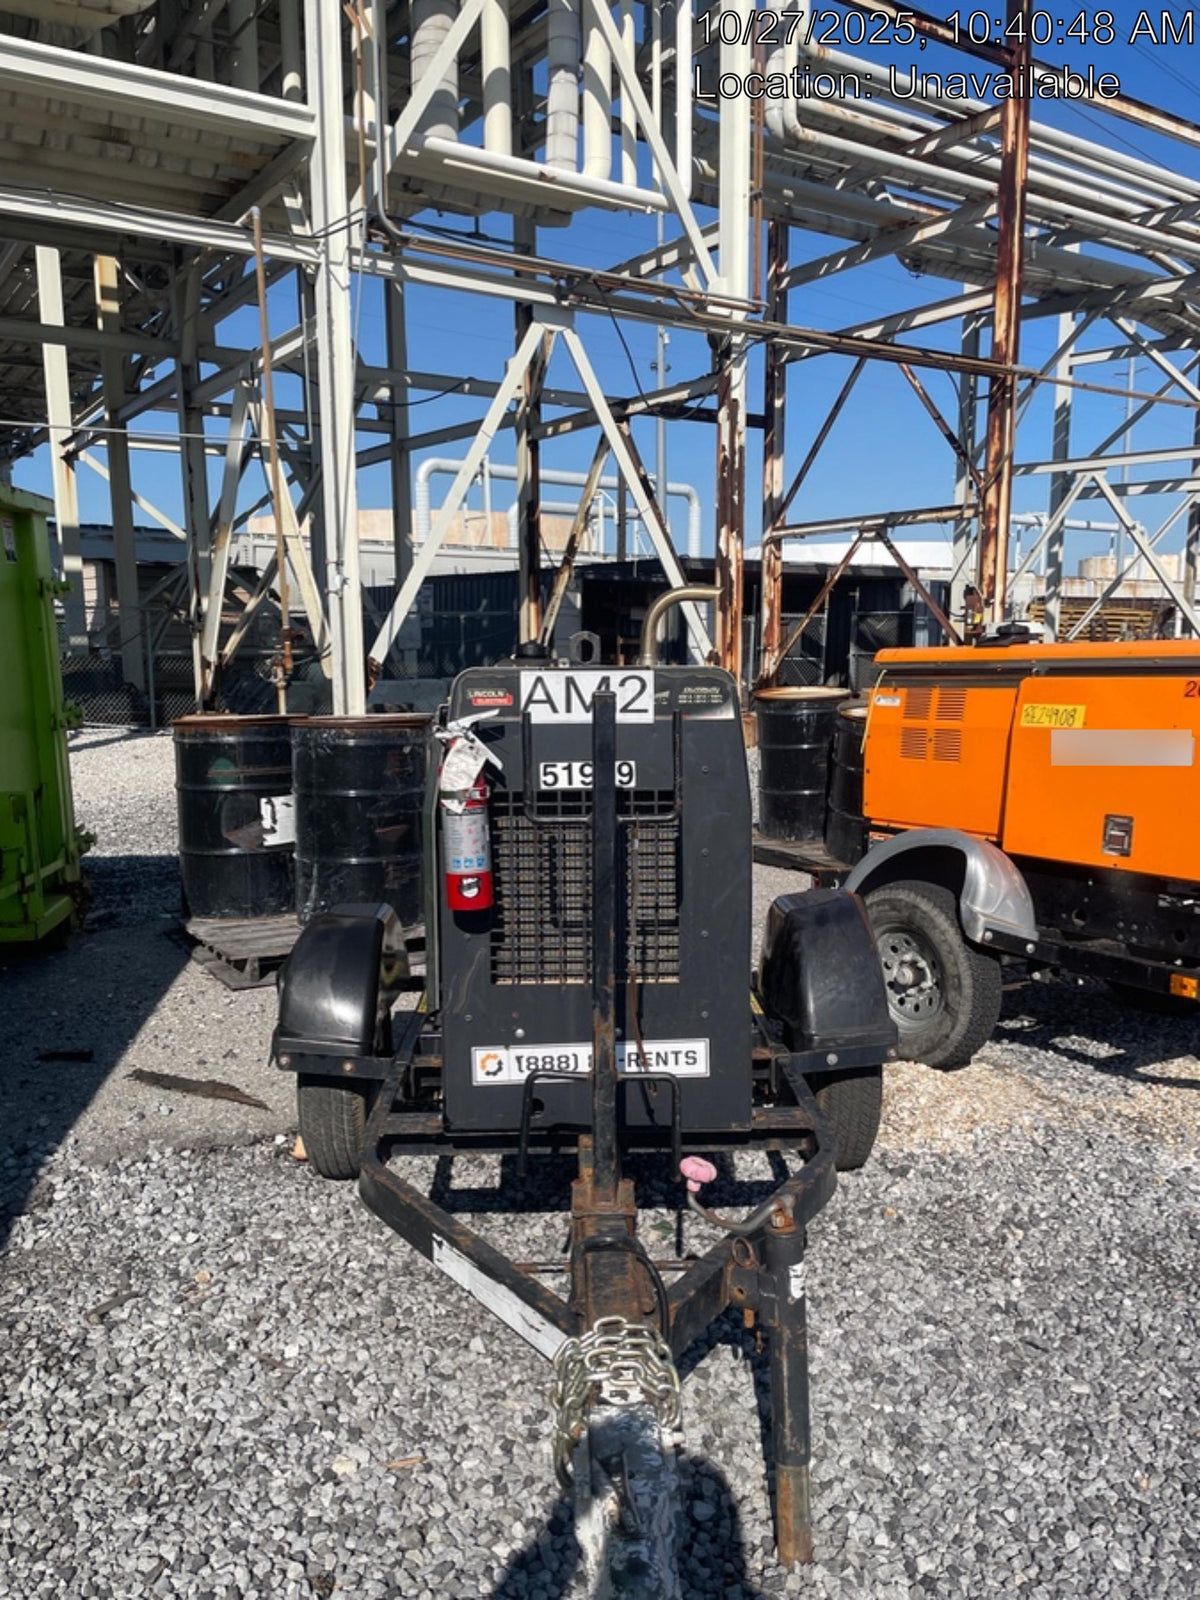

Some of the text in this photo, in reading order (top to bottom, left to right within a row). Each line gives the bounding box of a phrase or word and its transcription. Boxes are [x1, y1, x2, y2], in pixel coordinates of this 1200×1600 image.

[522, 675, 649, 714] AM2
[1184, 680, 1200, 698] 2
[541, 762, 634, 787] 5199
